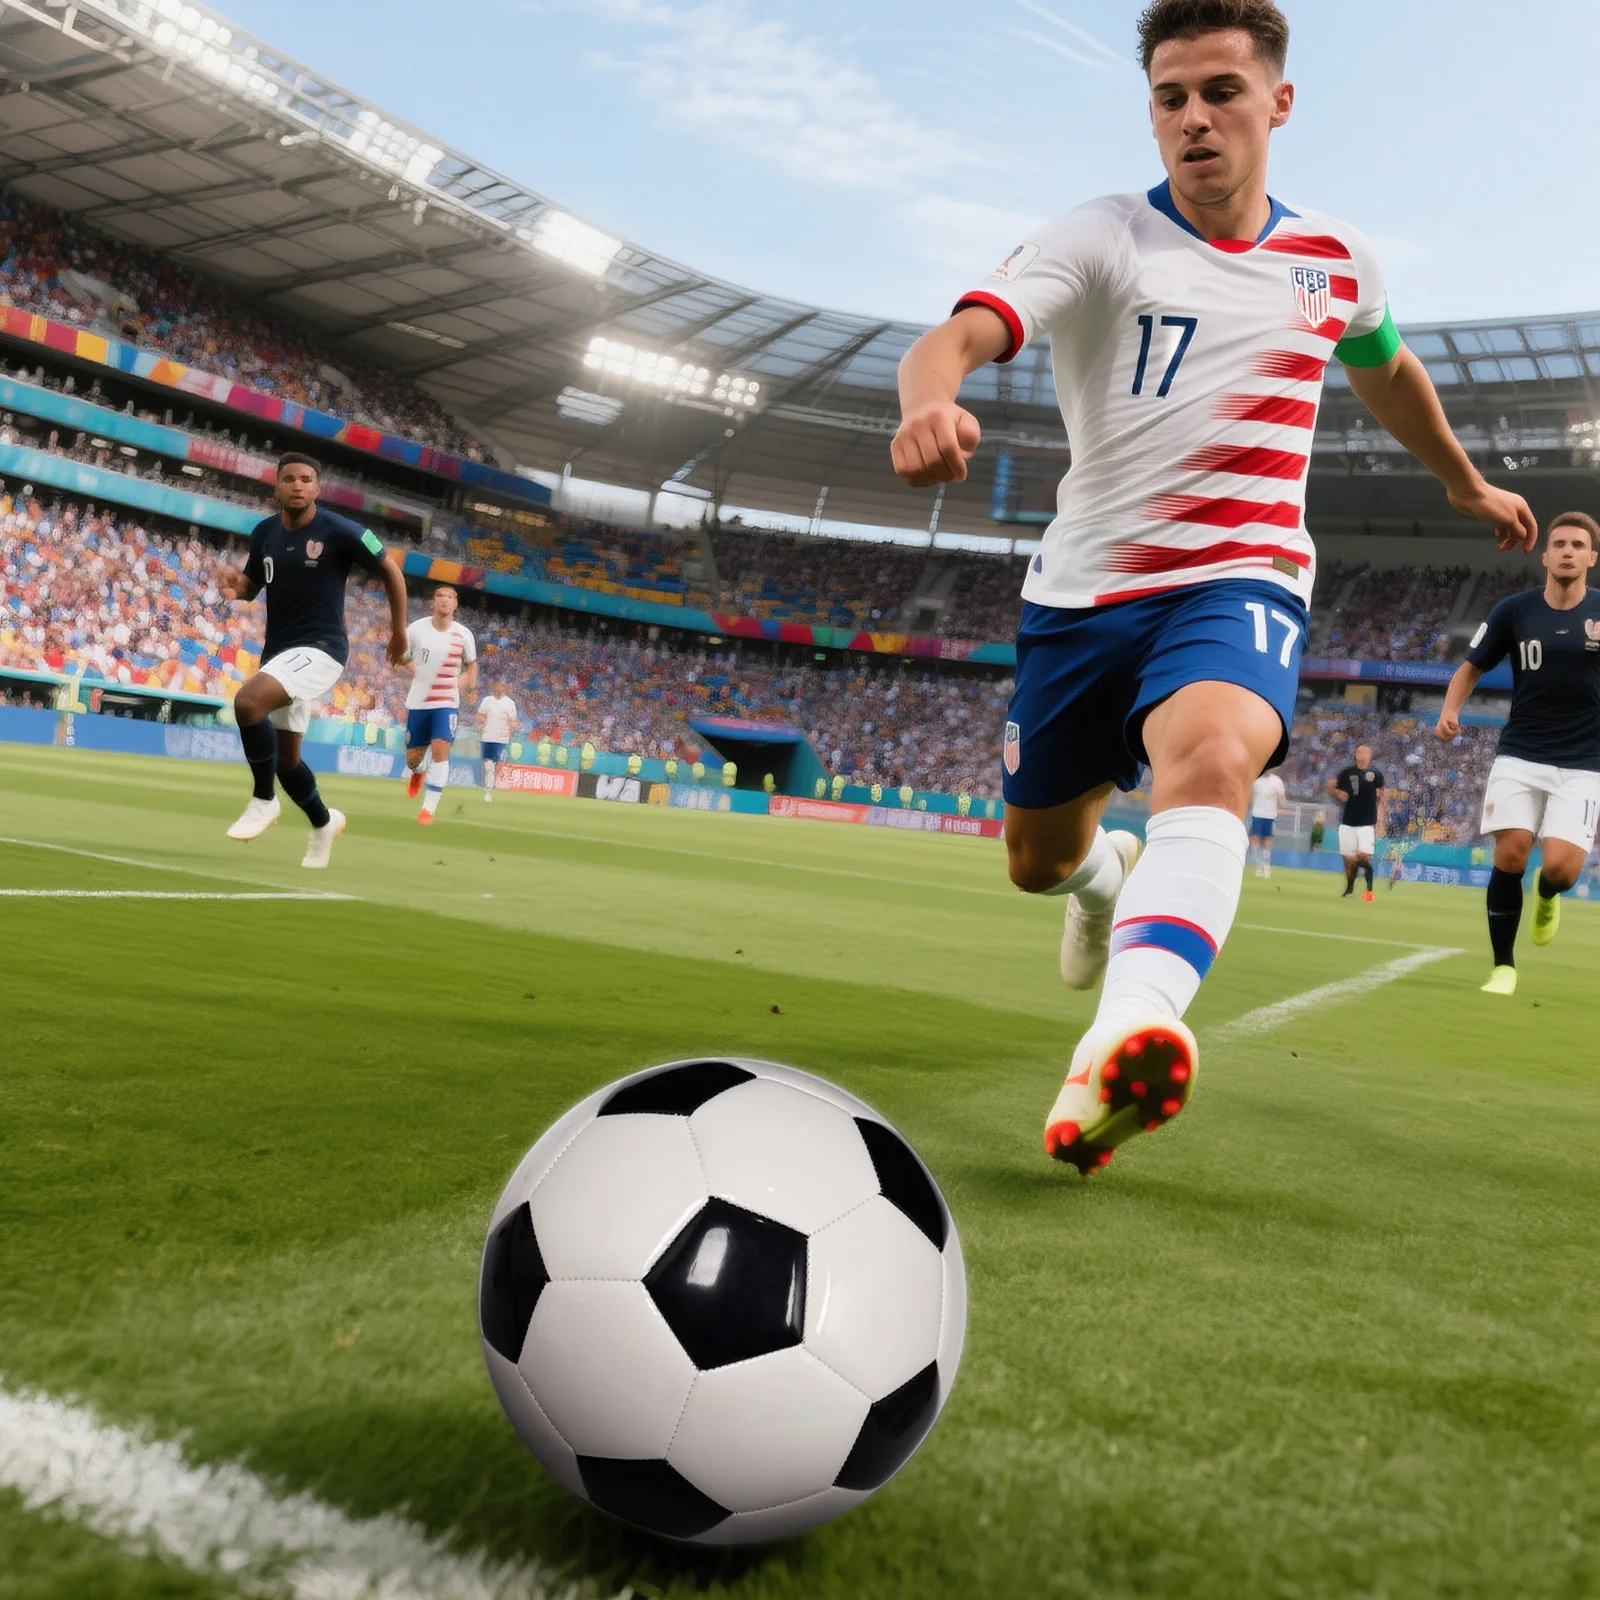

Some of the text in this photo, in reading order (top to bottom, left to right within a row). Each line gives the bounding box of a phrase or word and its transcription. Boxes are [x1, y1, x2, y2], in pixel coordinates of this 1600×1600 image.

[1131, 315, 1199, 398] 17
[1245, 602, 1300, 669] 17
[1520, 640, 1543, 671] 10
[284, 653, 313, 673] 17
